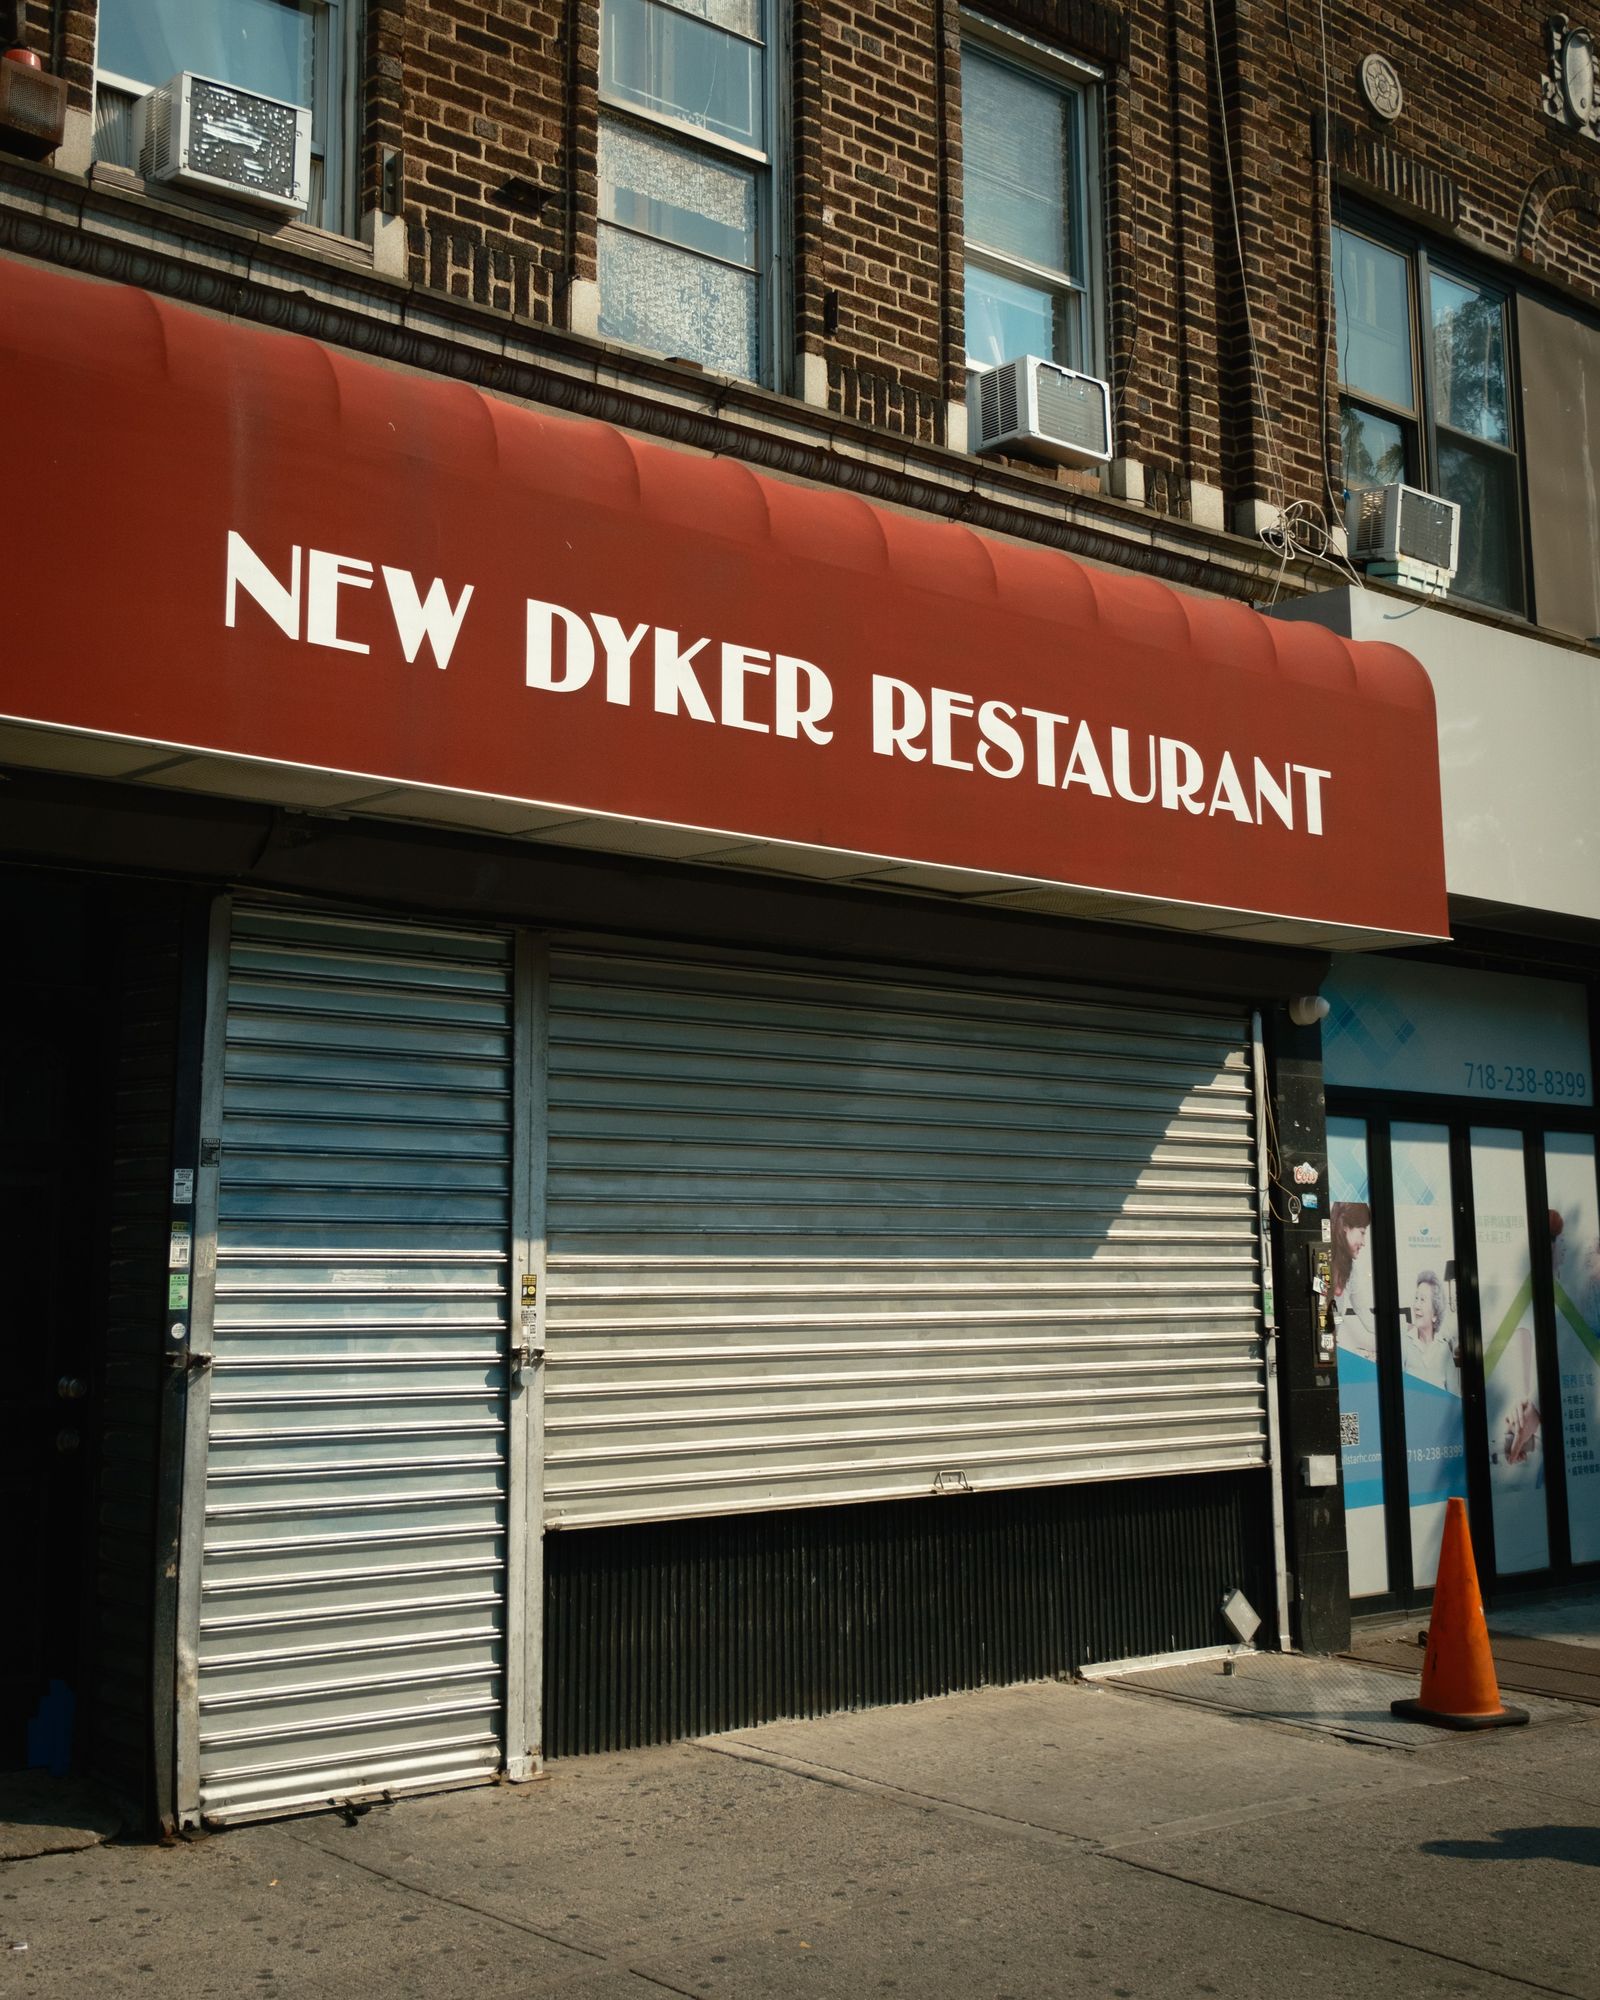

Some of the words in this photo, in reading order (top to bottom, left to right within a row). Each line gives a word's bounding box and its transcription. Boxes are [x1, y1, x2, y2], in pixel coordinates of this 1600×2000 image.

[225, 530, 475, 670] NEW
[525, 598, 834, 746] DYKER
[872, 673, 1332, 836] RESTAURANT
[1463, 1062, 1586, 1098] 718-238-8399
